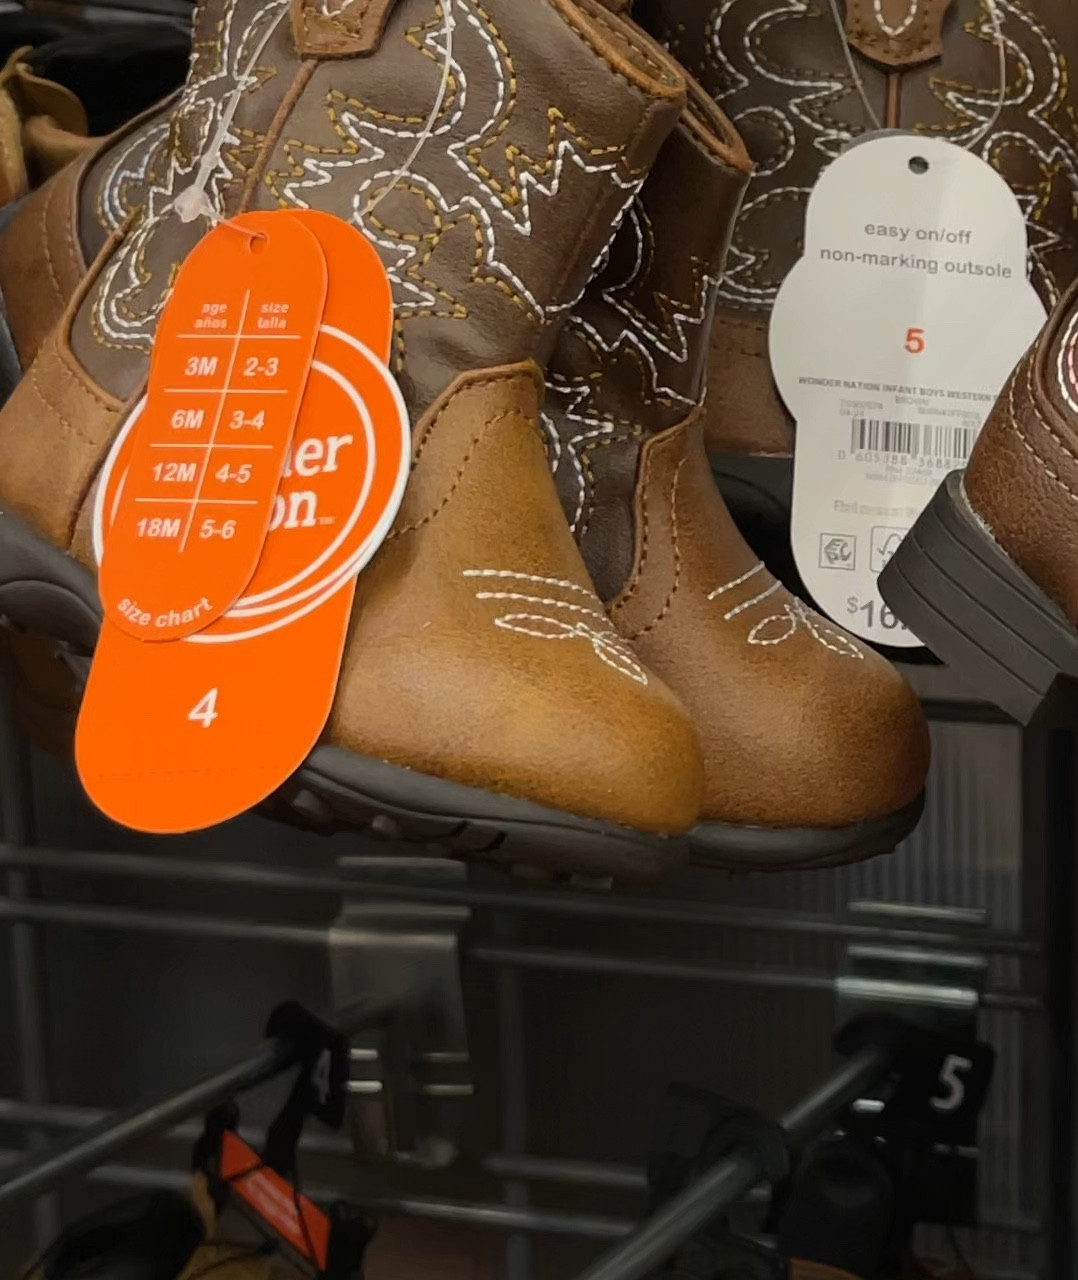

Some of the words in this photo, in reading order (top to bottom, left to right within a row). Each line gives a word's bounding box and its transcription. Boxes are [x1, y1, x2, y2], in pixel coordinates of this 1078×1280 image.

[865, 221, 910, 242] easy
[915, 226, 972, 245] on/off
[820, 248, 938, 275] non-marking
[944, 258, 1012, 280] outsole
[201, 302, 228, 318] age
[261, 301, 290, 316] size
[904, 328, 925, 354] 5
[184, 356, 217, 378] 3M
[242, 356, 280, 378] 2-3
[799, 376, 841, 388] WONDER
[843, 380, 880, 392] NATION
[883, 384, 918, 395] INFANT
[920, 388, 945, 398] BOYS
[948, 391, 991, 401] WESTERN
[171, 408, 205, 431] 6M
[229, 409, 265, 431] 3-4
[152, 461, 197, 484] 12M
[215, 462, 252, 484] 4-5
[136, 517, 181, 539] 18M
[199, 518, 236, 540] 5-6
[116, 596, 152, 629] size
[155, 596, 213, 629] chart
[188, 687, 218, 728] 4
[930, 1055, 973, 1112] 5
